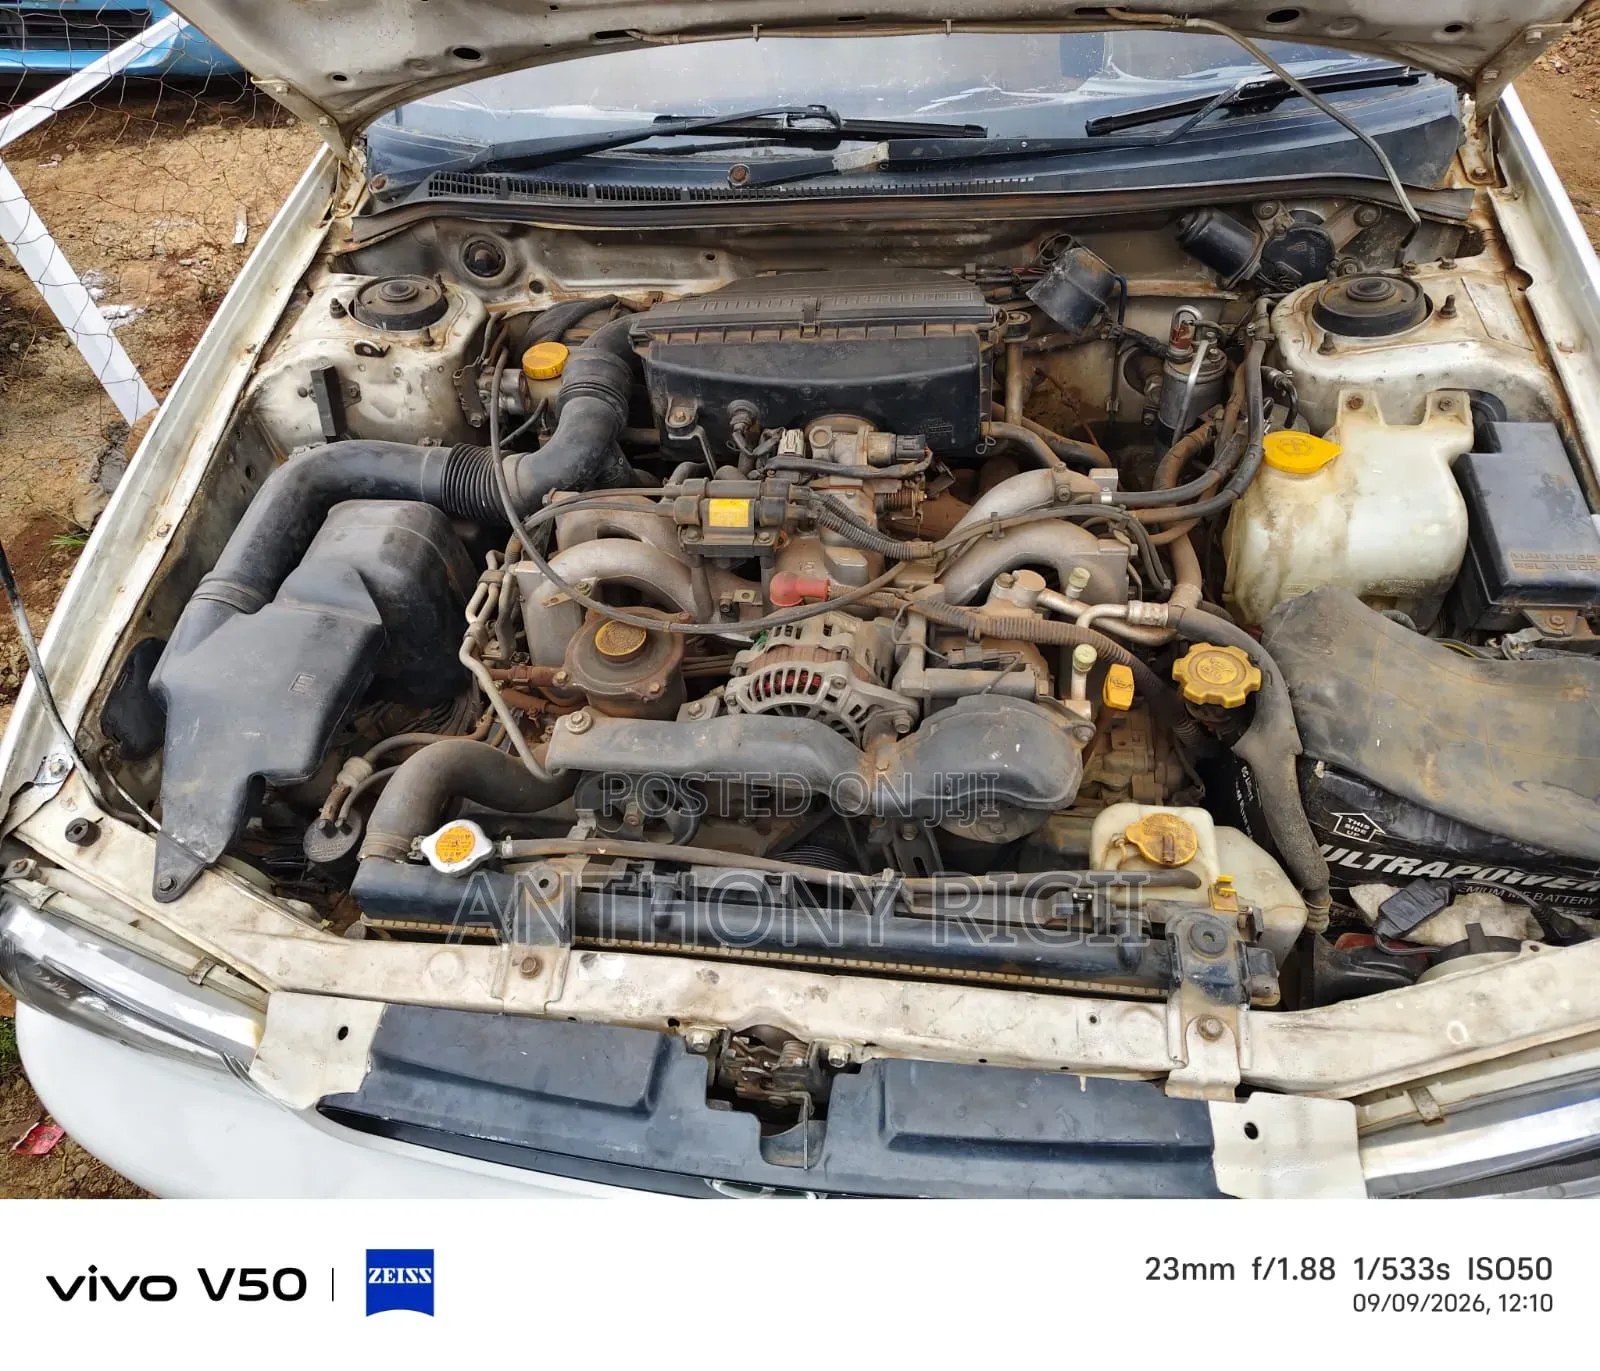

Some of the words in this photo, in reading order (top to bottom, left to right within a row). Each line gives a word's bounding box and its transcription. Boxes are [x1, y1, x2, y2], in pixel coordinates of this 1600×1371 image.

[1344, 823, 1368, 835] SIDE
[1347, 817, 1370, 830] THIS
[1533, 892, 1598, 905] BATTERY
